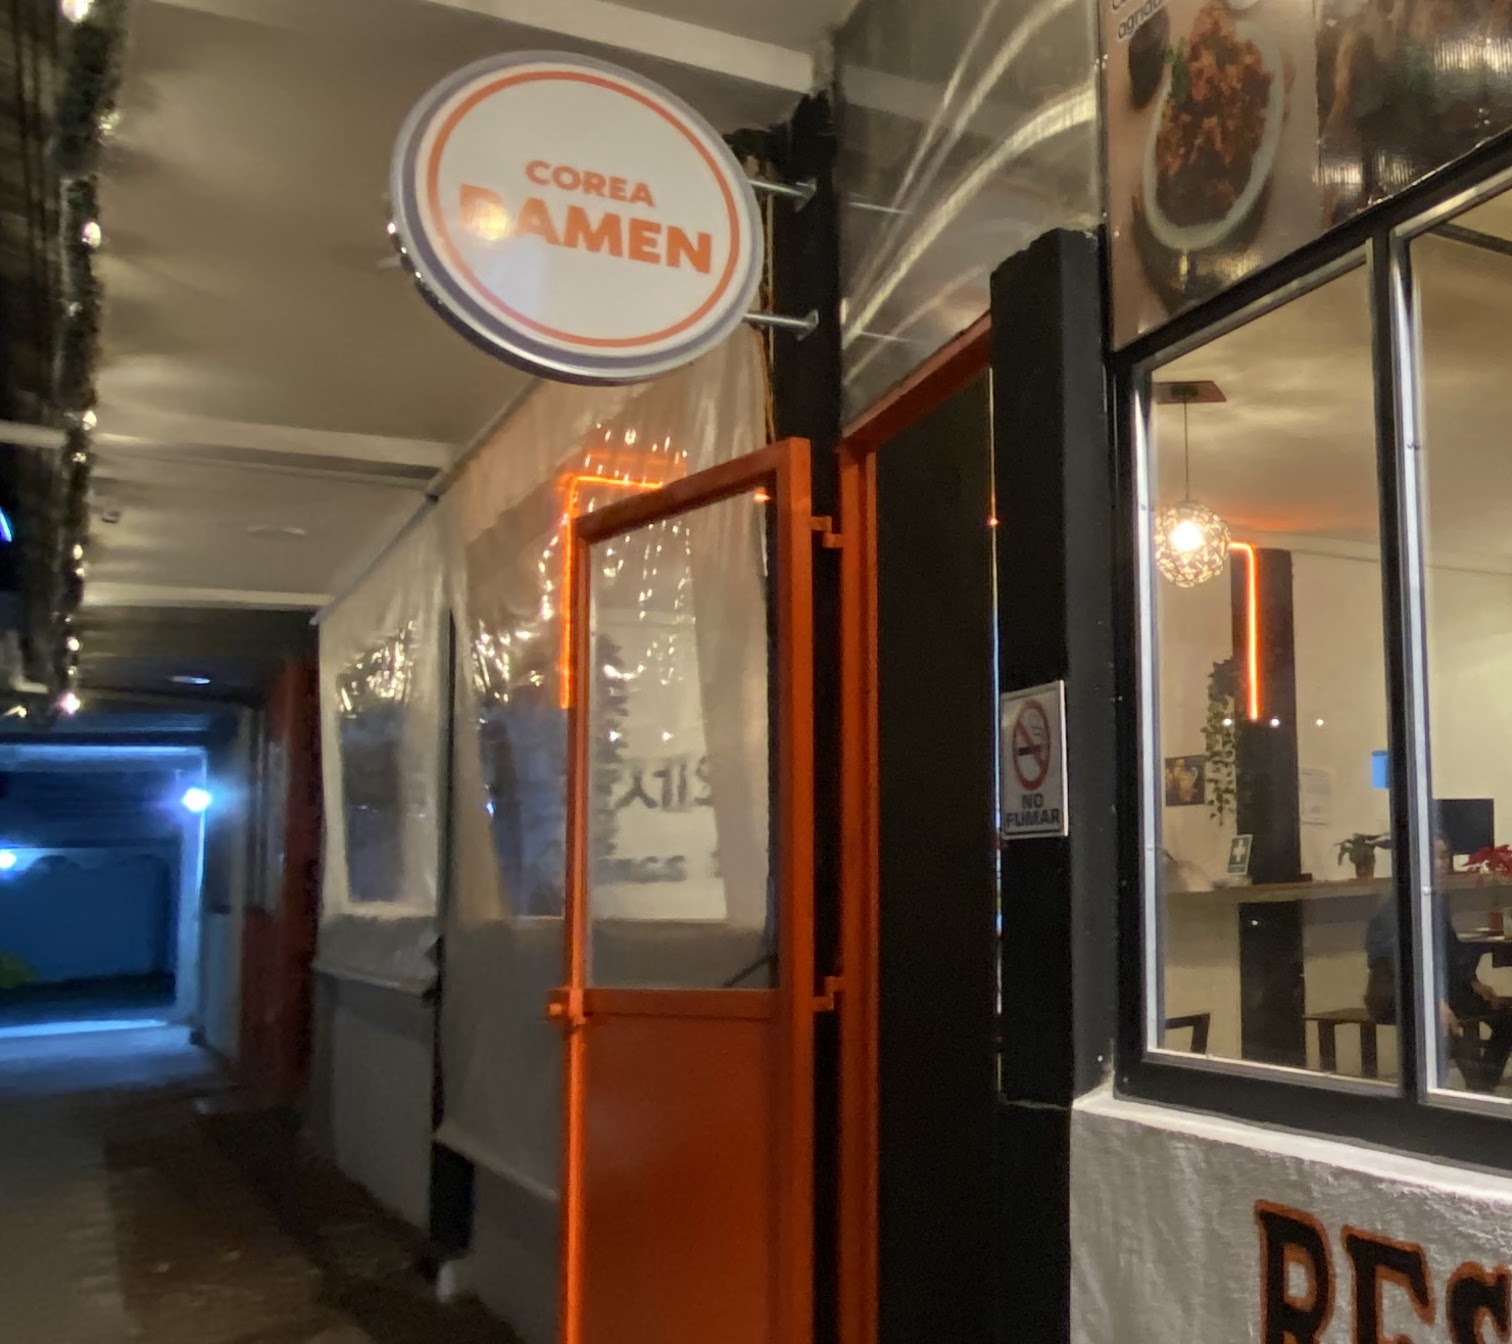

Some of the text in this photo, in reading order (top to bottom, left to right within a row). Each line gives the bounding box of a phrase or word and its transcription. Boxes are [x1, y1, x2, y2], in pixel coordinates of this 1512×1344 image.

[524, 160, 656, 208] COREA
[1021, 792, 1044, 810] NO
[1005, 808, 1061, 829] FUMAR
